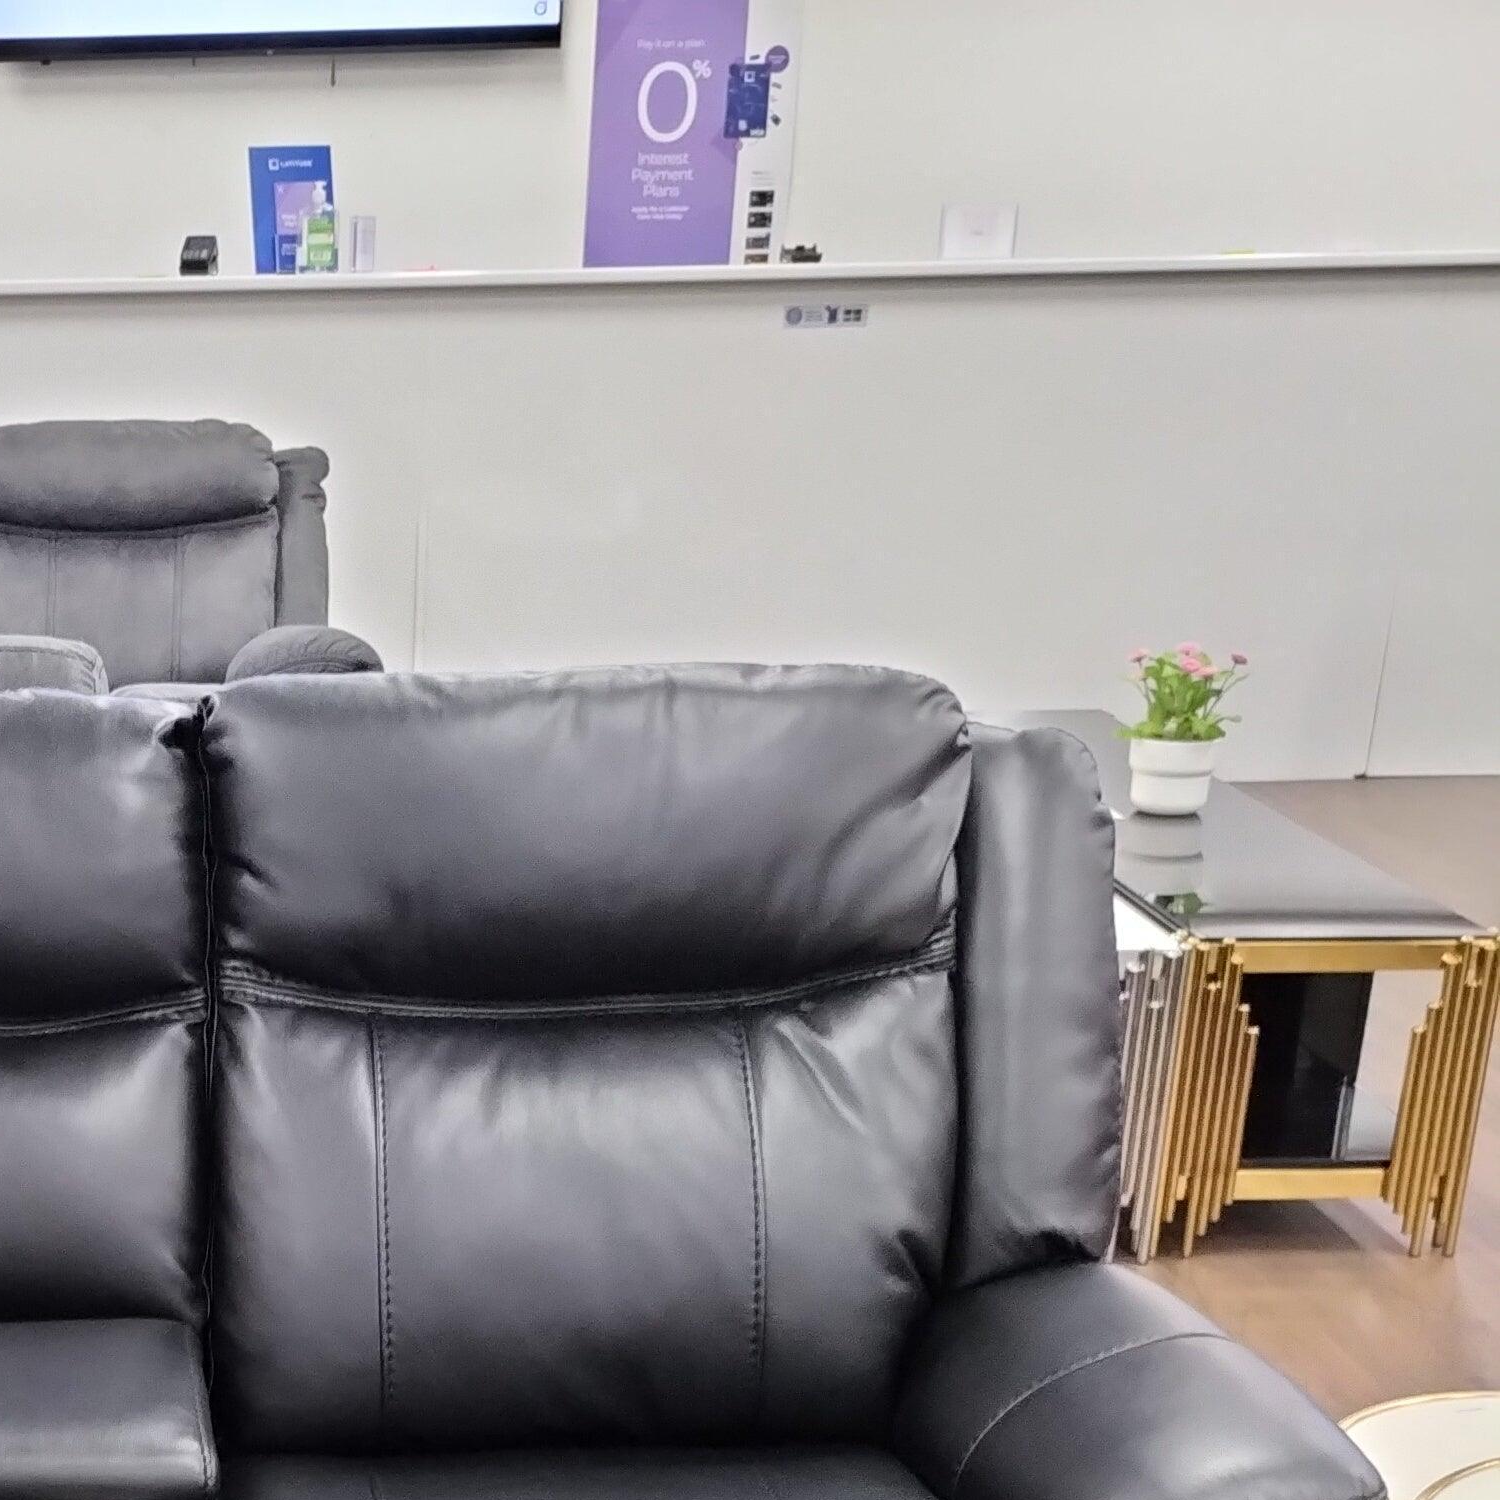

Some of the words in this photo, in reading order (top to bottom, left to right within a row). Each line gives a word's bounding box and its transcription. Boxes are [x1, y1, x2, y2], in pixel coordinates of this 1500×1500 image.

[638, 59, 712, 142] 0%
[637, 152, 690, 166] Interest
[632, 168, 693, 184] Payment
